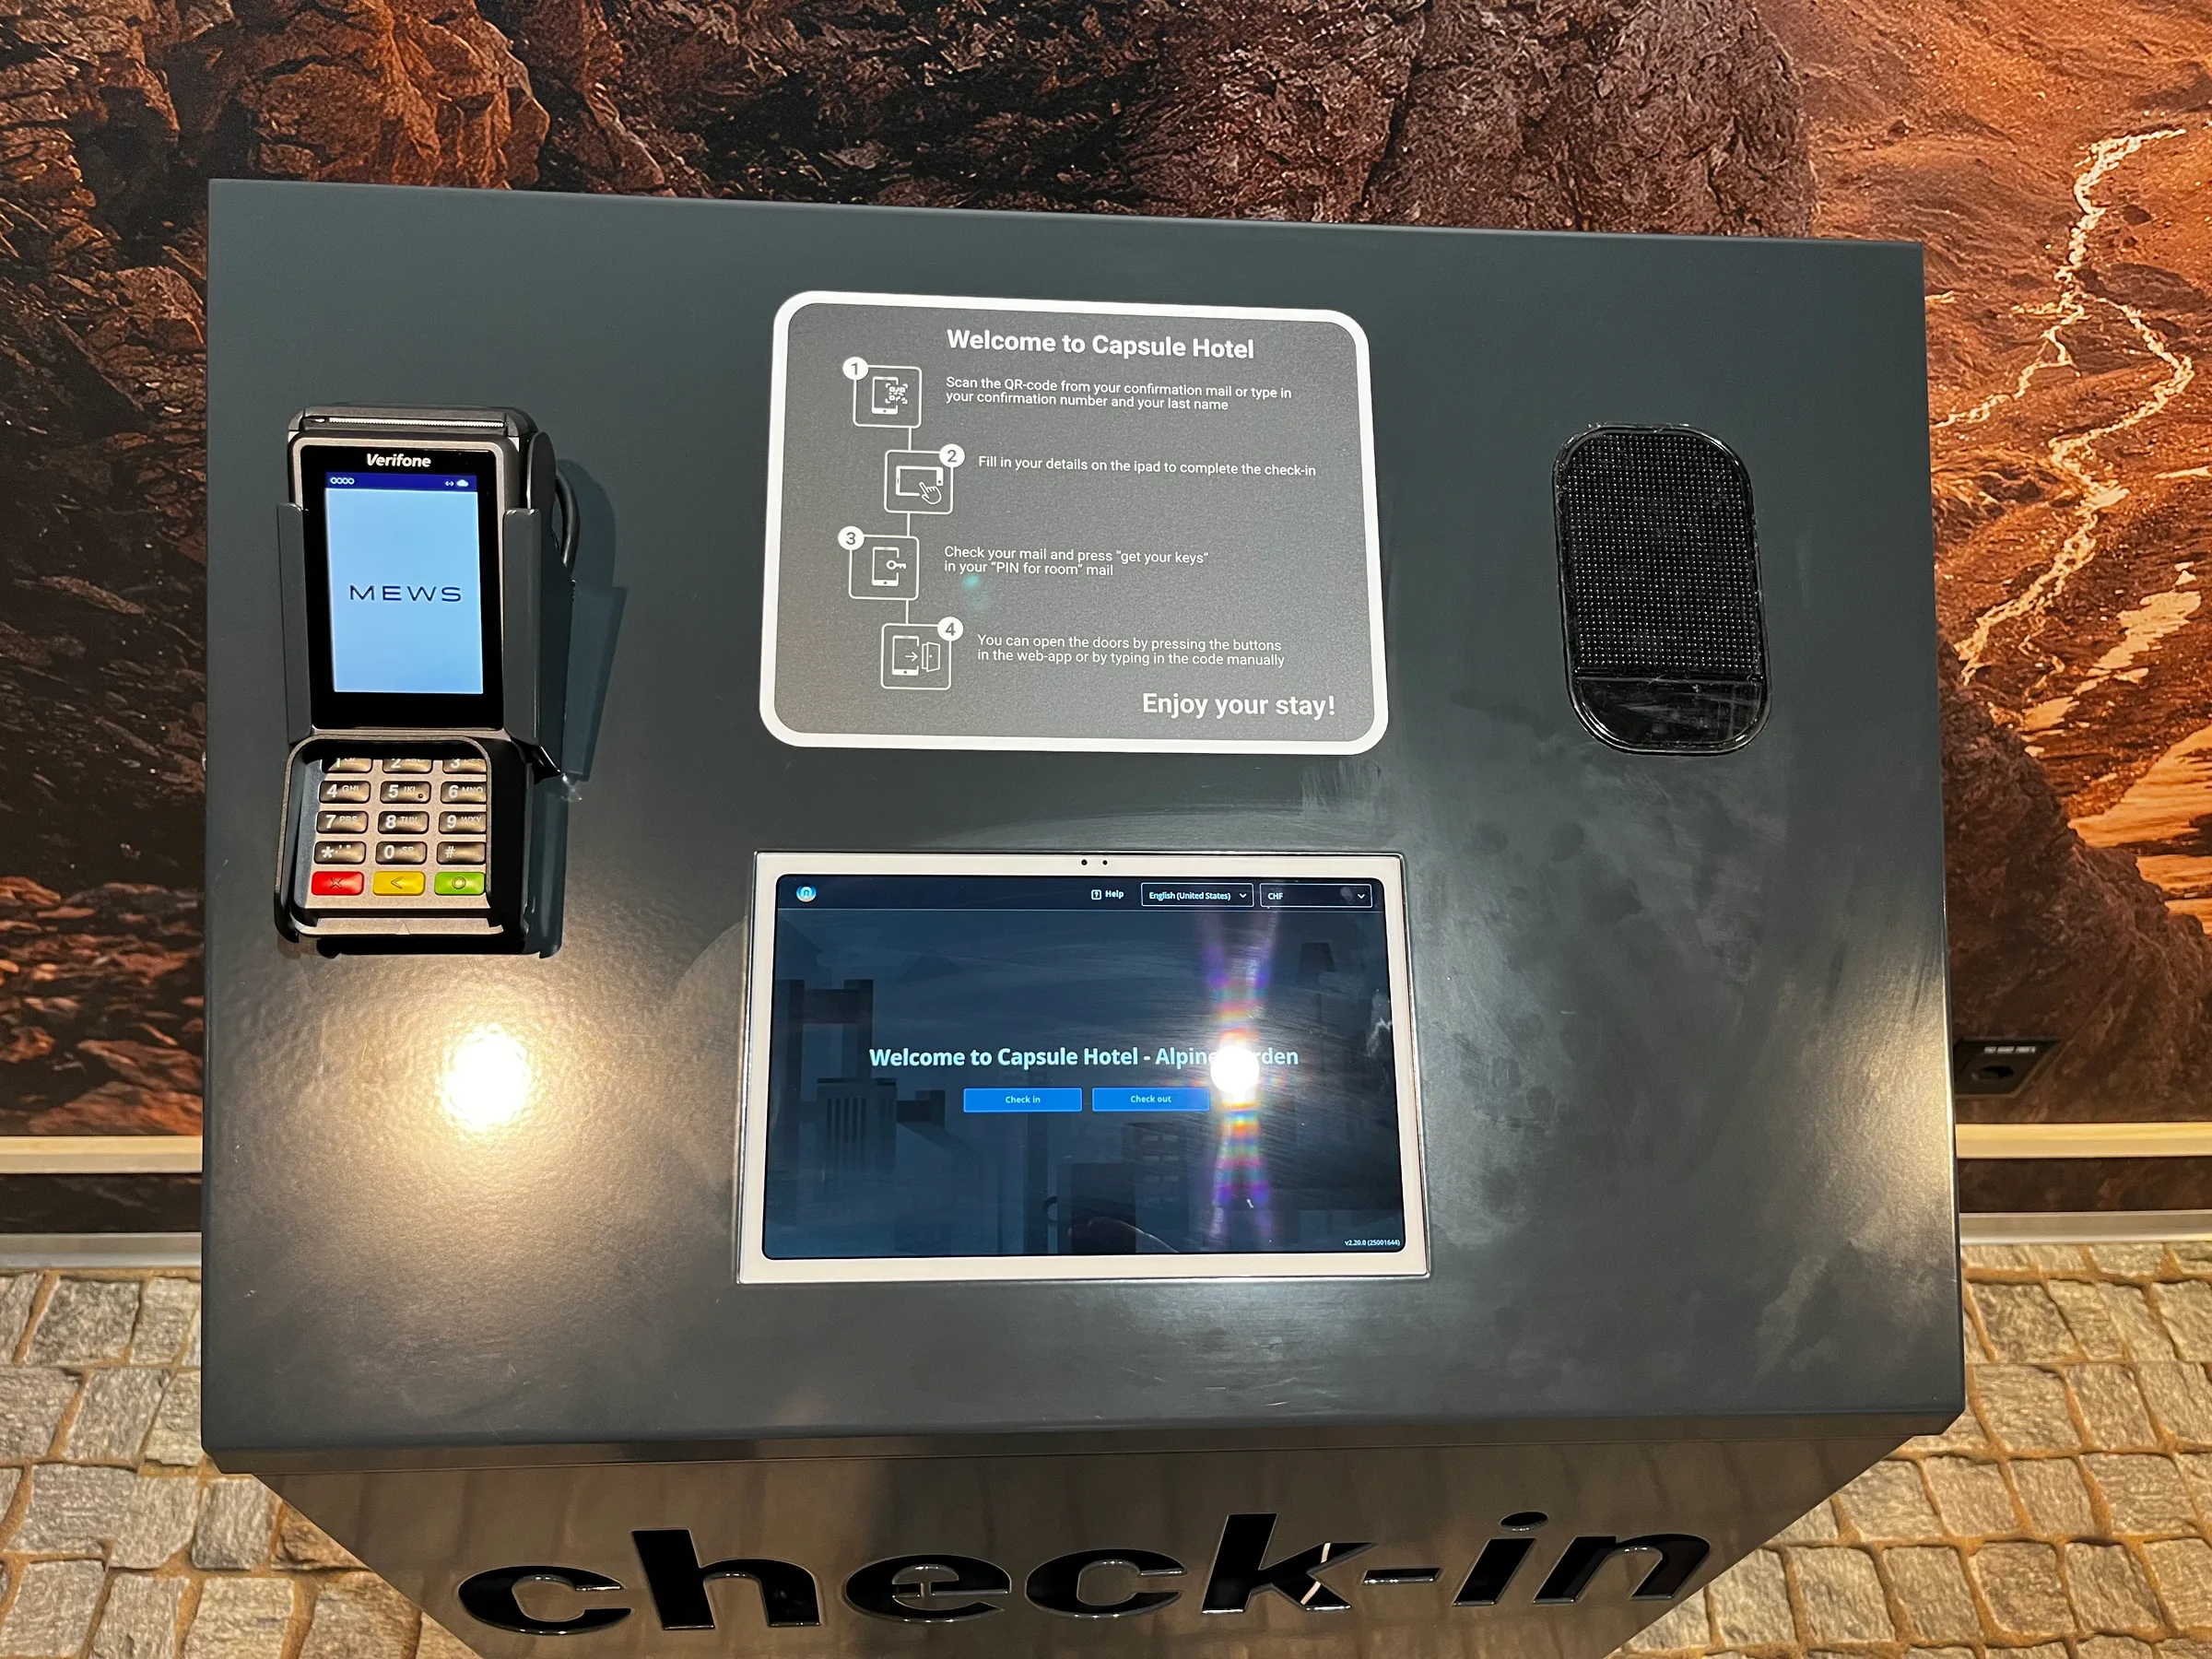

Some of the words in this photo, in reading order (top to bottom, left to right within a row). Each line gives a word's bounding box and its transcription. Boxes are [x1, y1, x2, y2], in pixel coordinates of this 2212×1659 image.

[947, 329, 1055, 353] Welcome
[1062, 335, 1086, 353] to
[1092, 335, 1186, 359] Capsule
[1193, 338, 1254, 359] Hotel
[852, 363, 859, 374] 1
[946, 376, 978, 388] Scan
[981, 378, 1001, 389] the
[1005, 379, 1057, 392] QR-code
[1061, 381, 1090, 392] from
[1094, 382, 1121, 395] your
[1124, 382, 1202, 396] confirmation
[1206, 385, 1231, 397] mail
[1235, 387, 1248, 398] or
[1251, 387, 1277, 401] type
[1280, 388, 1291, 399] in
[946, 392, 973, 405] your
[976, 391, 1056, 406] confirmation
[1060, 394, 1108, 407] number
[1111, 395, 1134, 407] and
[1137, 399, 1165, 410] your
[1168, 397, 1190, 409] last
[1194, 400, 1229, 410] name
[367, 453, 431, 467] Verifone
[947, 451, 957, 462] 2
[978, 455, 997, 467] Fill
[1000, 456, 1012, 468] in
[1015, 459, 1042, 472] your
[1045, 458, 1088, 471] details
[1090, 461, 1107, 471] on
[1111, 460, 1131, 472] the
[1134, 461, 1161, 474] ipad
[1164, 462, 1177, 473] to
[1180, 462, 1238, 476] complete
[1241, 463, 1261, 475] the
[1265, 464, 1316, 477] check-in
[846, 533, 855, 544] 3
[944, 546, 984, 559] Check
[988, 549, 1016, 562] your
[1019, 547, 1046, 560] mail
[1050, 549, 1074, 560] and
[1077, 552, 1112, 562] press
[1144, 553, 1171, 565] your
[944, 561, 957, 571] in
[959, 563, 988, 574] your
[1023, 562, 1041, 574] for
[1086, 564, 1113, 575] mail
[349, 584, 461, 602] MEWS
[946, 623, 956, 635] 4
[978, 634, 1002, 647] You
[1006, 637, 1030, 647] can
[1033, 637, 1065, 650] open
[1068, 636, 1089, 648] the
[1093, 636, 1129, 649] doors
[1133, 637, 1148, 652] by
[1151, 638, 1206, 653] pressing
[1209, 638, 1230, 650] the
[1233, 639, 1282, 651] buttons
[978, 650, 989, 661] in
[993, 649, 1013, 662] the
[1017, 650, 1072, 665] web-app
[1076, 653, 1088, 663] or
[1092, 651, 1107, 665] by
[1111, 652, 1150, 665] typing
[1153, 653, 1165, 664] in
[1168, 652, 1189, 665] the
[1192, 653, 1223, 665] code
[1227, 653, 1285, 668] manually
[1142, 692, 1208, 718] Enjoy
[1215, 698, 1268, 719] your
[1275, 695, 1335, 721] stay!
[327, 784, 337, 797] 4
[389, 784, 398, 798] 5
[449, 785, 458, 798] 6
[326, 815, 336, 829] 7
[385, 815, 396, 829] 8
[447, 815, 456, 829] 9
[384, 845, 394, 859] 0
[1105, 889, 1124, 899] Help
[1149, 892, 1175, 901] English
[1176, 892, 1204, 900] (United
[1206, 892, 1230, 900] States)
[869, 1048, 965, 1067] Welcome
[971, 1050, 993, 1067] to
[997, 1047, 1076, 1070] Capsule
[1084, 1048, 1138, 1065] Hotel
[459, 1510, 1711, 1635] check-in
